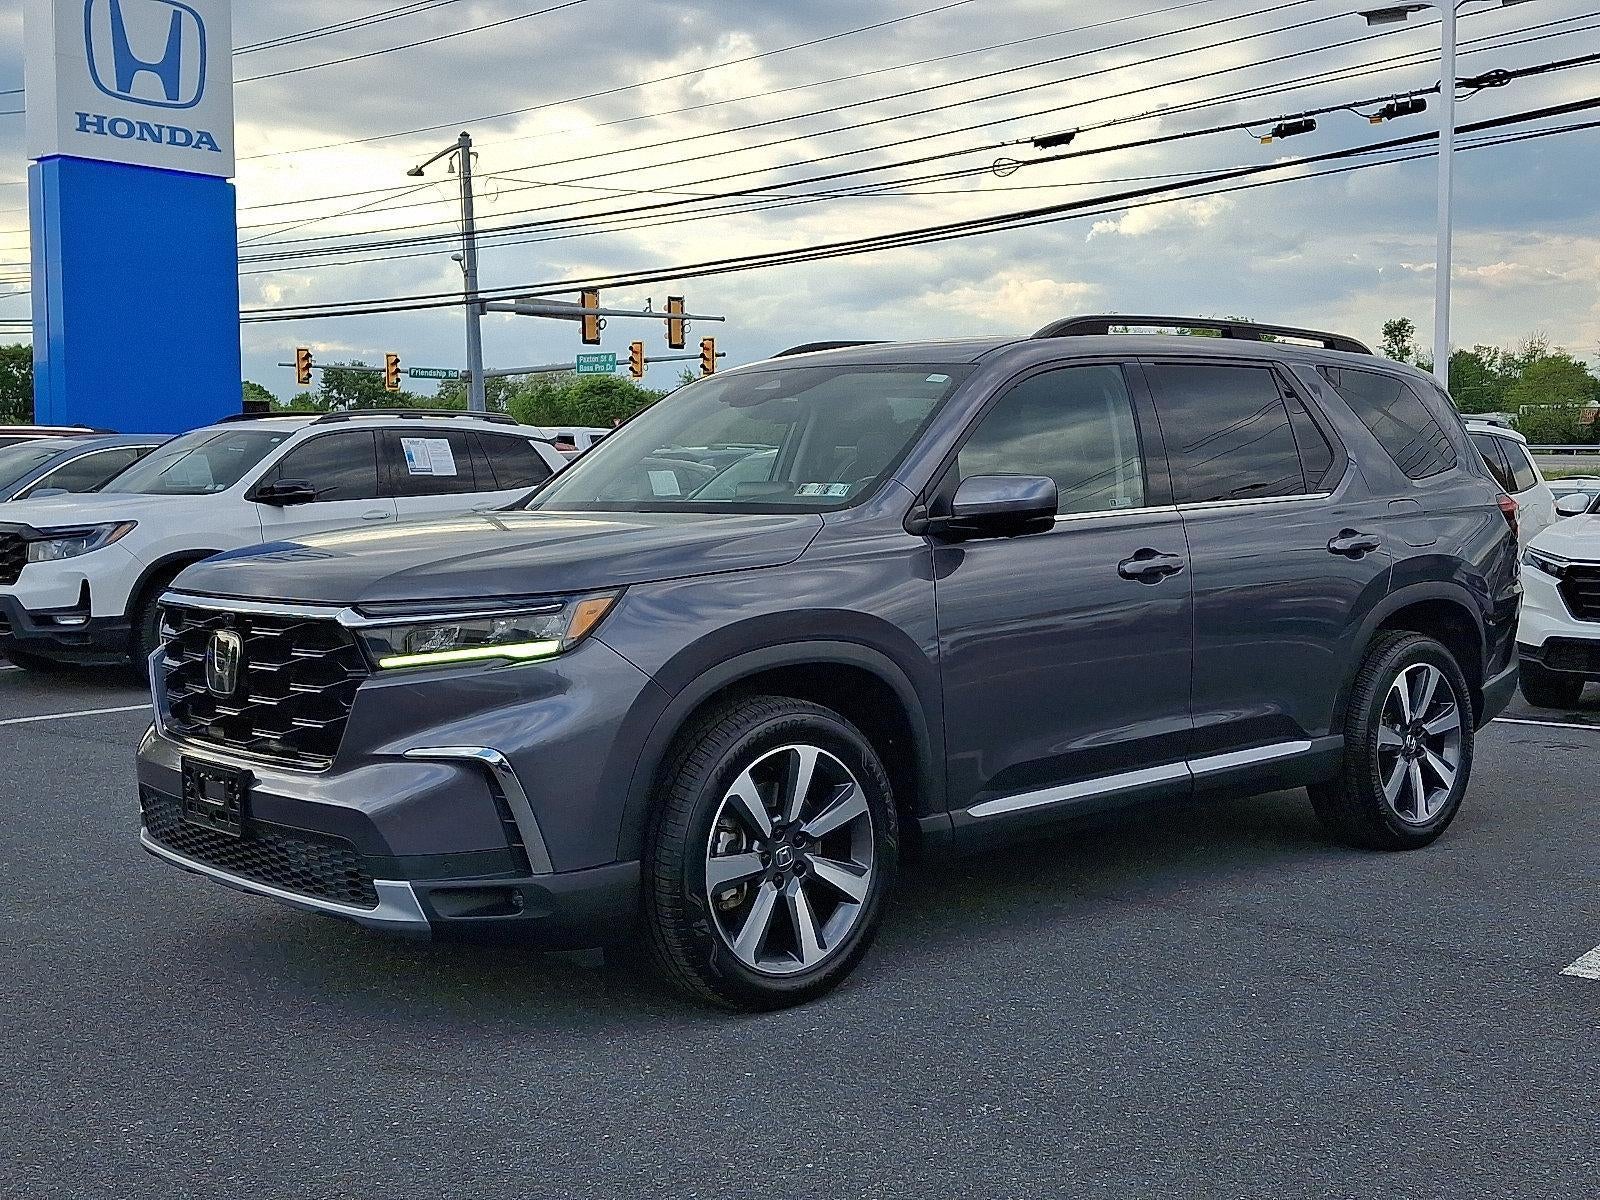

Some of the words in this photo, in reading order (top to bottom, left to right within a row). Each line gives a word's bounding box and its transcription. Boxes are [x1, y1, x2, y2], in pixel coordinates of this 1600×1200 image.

[75, 111, 222, 153] HONDA
[578, 355, 598, 363] Paxton
[600, 354, 607, 362] St
[595, 363, 604, 371] Pro
[606, 363, 613, 371] Dr
[411, 368, 446, 379] Friendship
[448, 370, 458, 378] Rd
